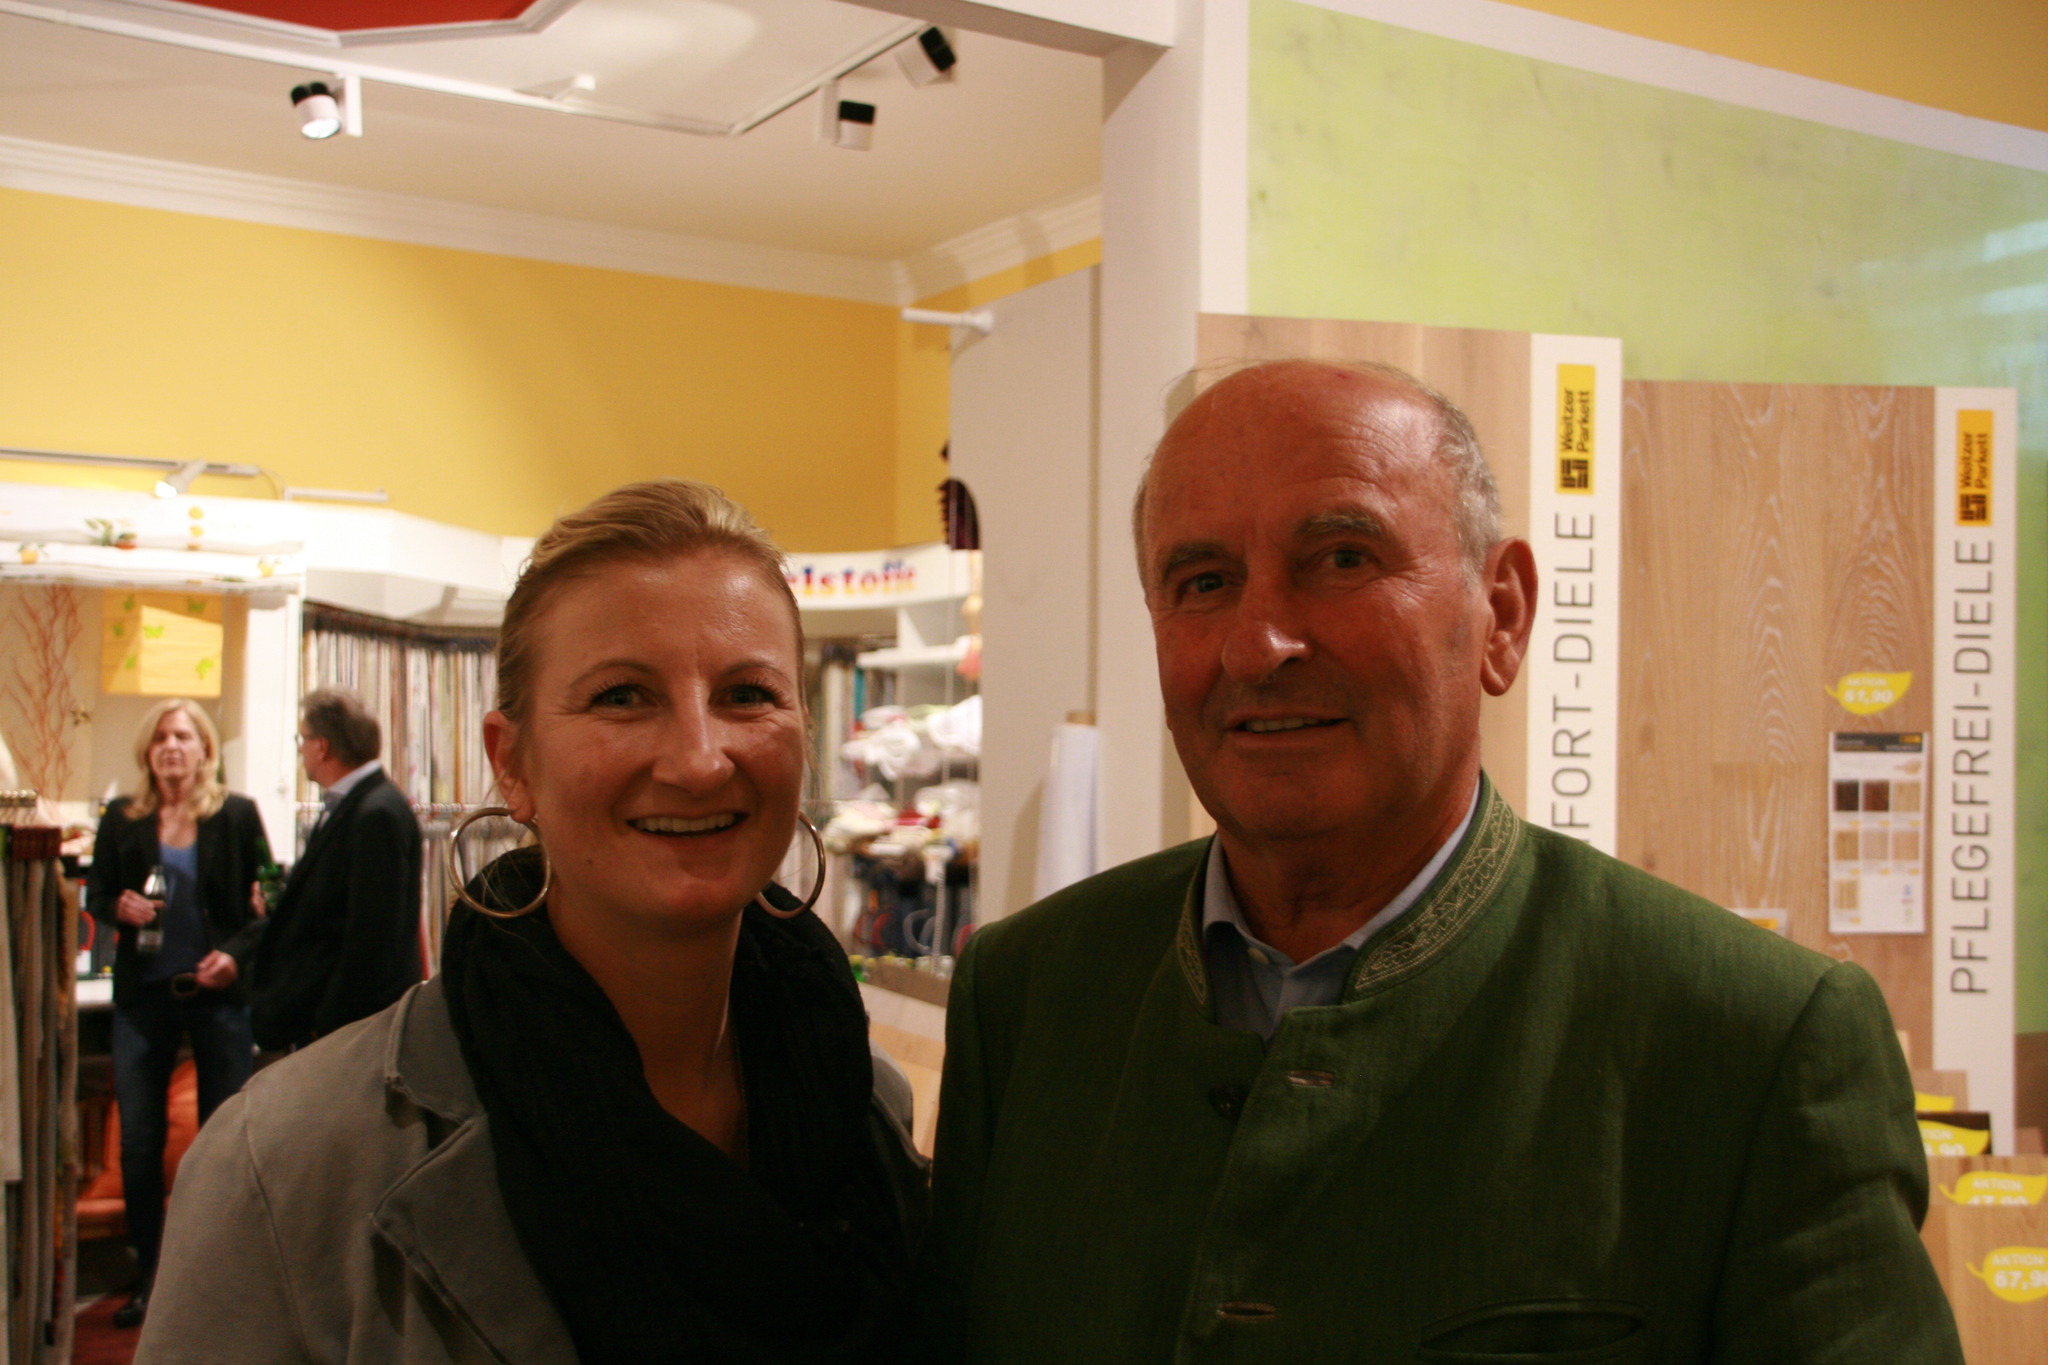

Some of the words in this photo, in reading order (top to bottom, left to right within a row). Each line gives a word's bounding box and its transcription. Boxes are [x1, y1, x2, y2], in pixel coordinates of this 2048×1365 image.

[1560, 387, 1574, 452] Weitzer
[1576, 390, 1590, 453] Parkett
[1551, 513, 1593, 843] FORT-DIELE
[1950, 540, 1992, 995] PFLEGEFREI-DIELE
[1971, 1178, 2024, 1192] AKTION
[1992, 1253, 2046, 1267] AKTION
